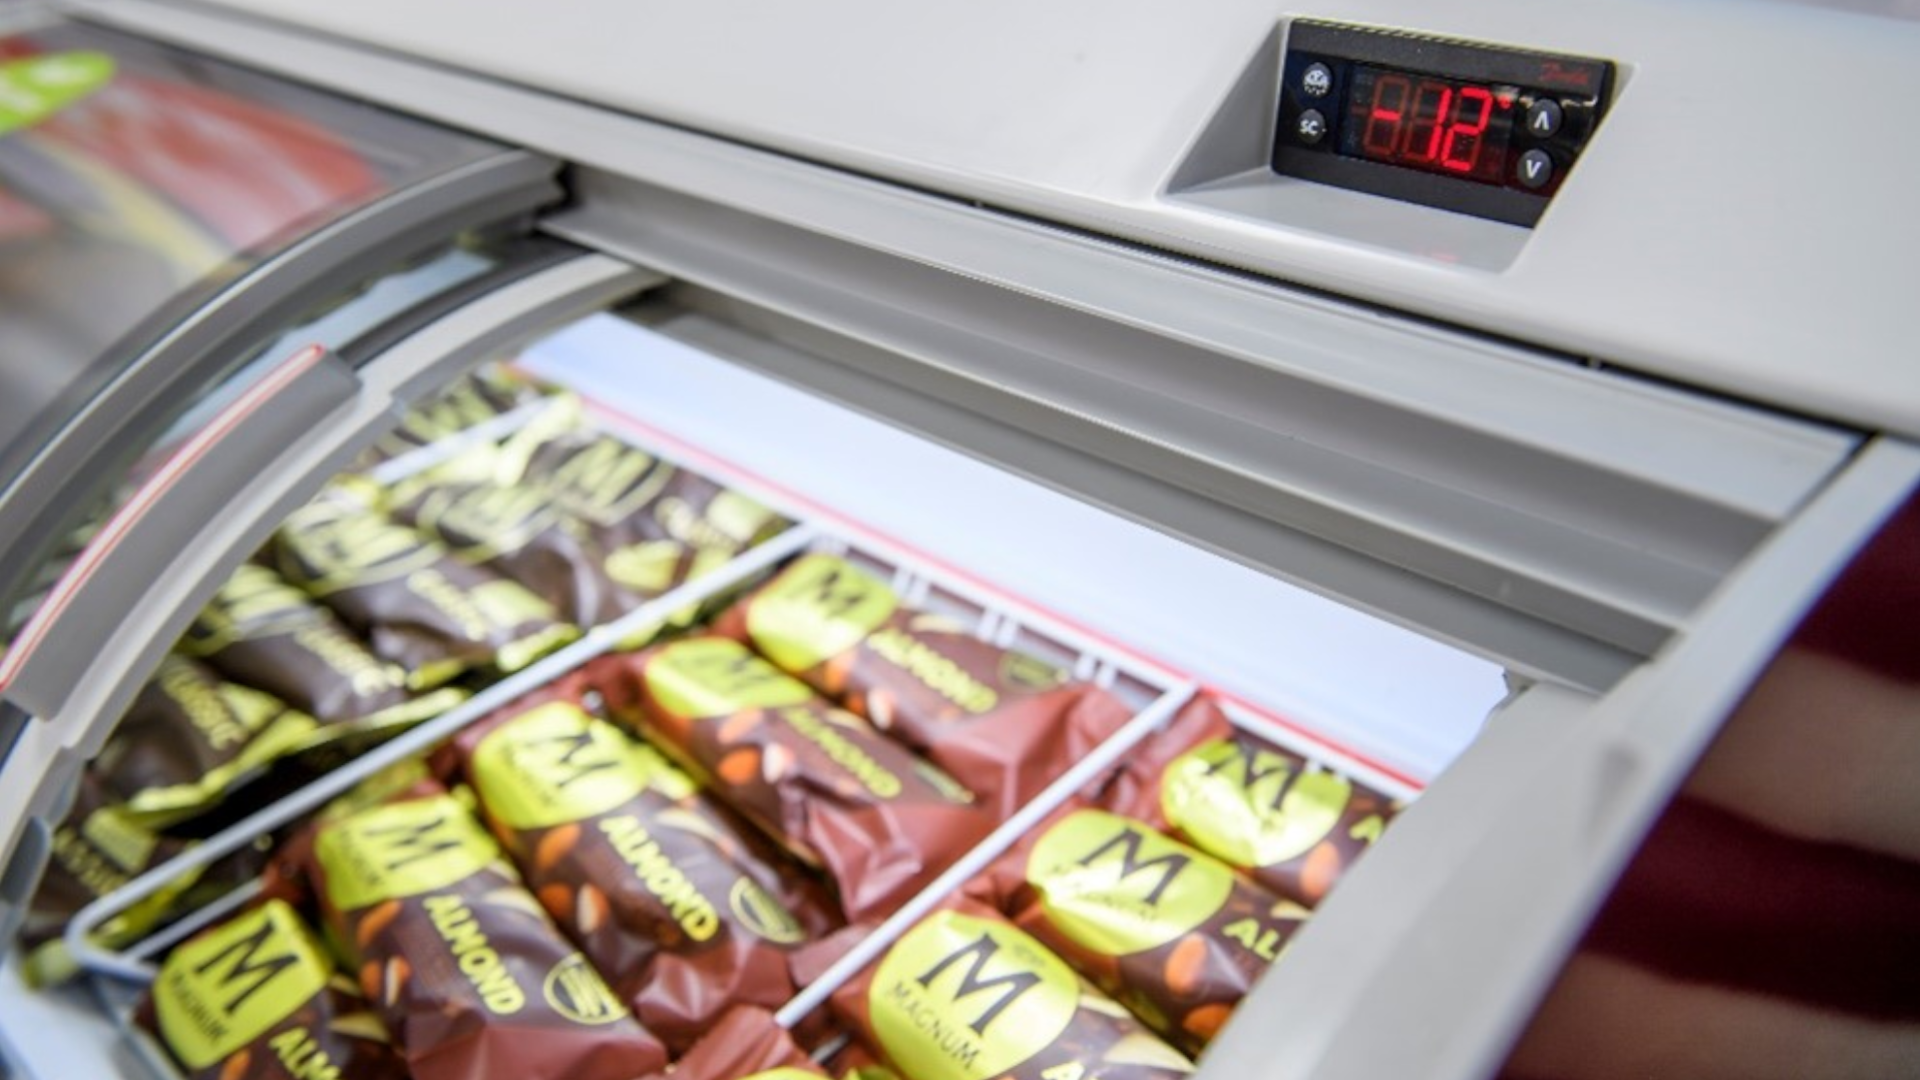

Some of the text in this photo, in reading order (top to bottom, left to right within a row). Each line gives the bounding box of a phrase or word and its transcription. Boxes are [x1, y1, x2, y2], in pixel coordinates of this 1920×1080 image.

[866, 628, 997, 714] ALMOND
[598, 814, 719, 941] ALMOND
[1078, 827, 1191, 907] M
[193, 918, 300, 1018] M
[423, 894, 525, 1015] ALMOND
[917, 932, 1042, 1037] M
[890, 980, 981, 1070] MAGNUM
